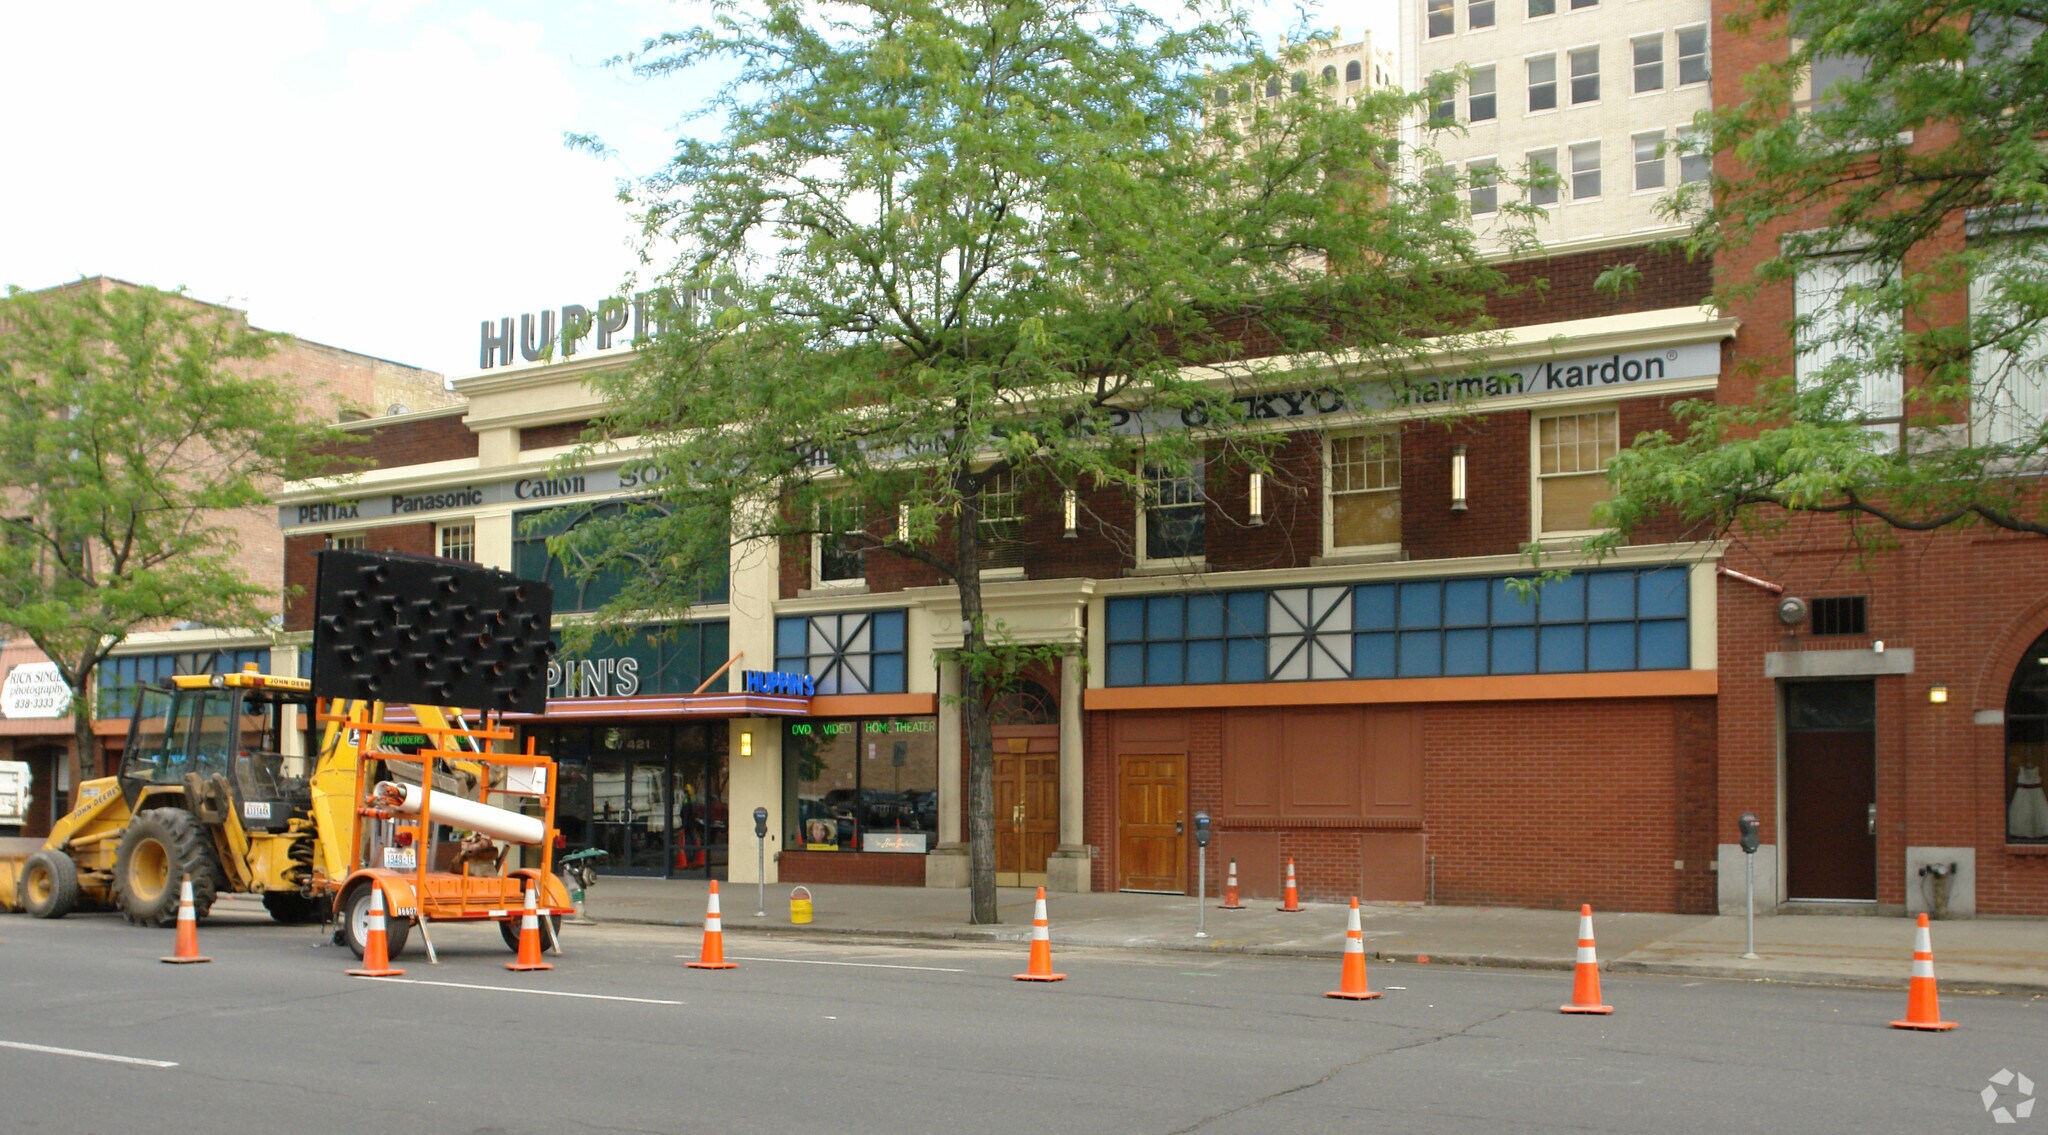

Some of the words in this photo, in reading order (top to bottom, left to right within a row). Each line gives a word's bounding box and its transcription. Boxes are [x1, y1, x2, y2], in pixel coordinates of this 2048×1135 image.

[1181, 385, 1344, 427] OKYO
[514, 474, 586, 499] Canon
[391, 485, 482, 514] Panasonic
[298, 500, 360, 524] PENTAX
[9, 671, 32, 685] RICK
[269, 678, 289, 686] JOHN
[9, 683, 64, 698] photography
[14, 698, 54, 709] 838-3333
[791, 724, 812, 735] DVD
[822, 723, 852, 735] VIDEO
[894, 721, 936, 733] THEATER
[626, 740, 651, 749] 421
[72, 803, 92, 820] JOHN
